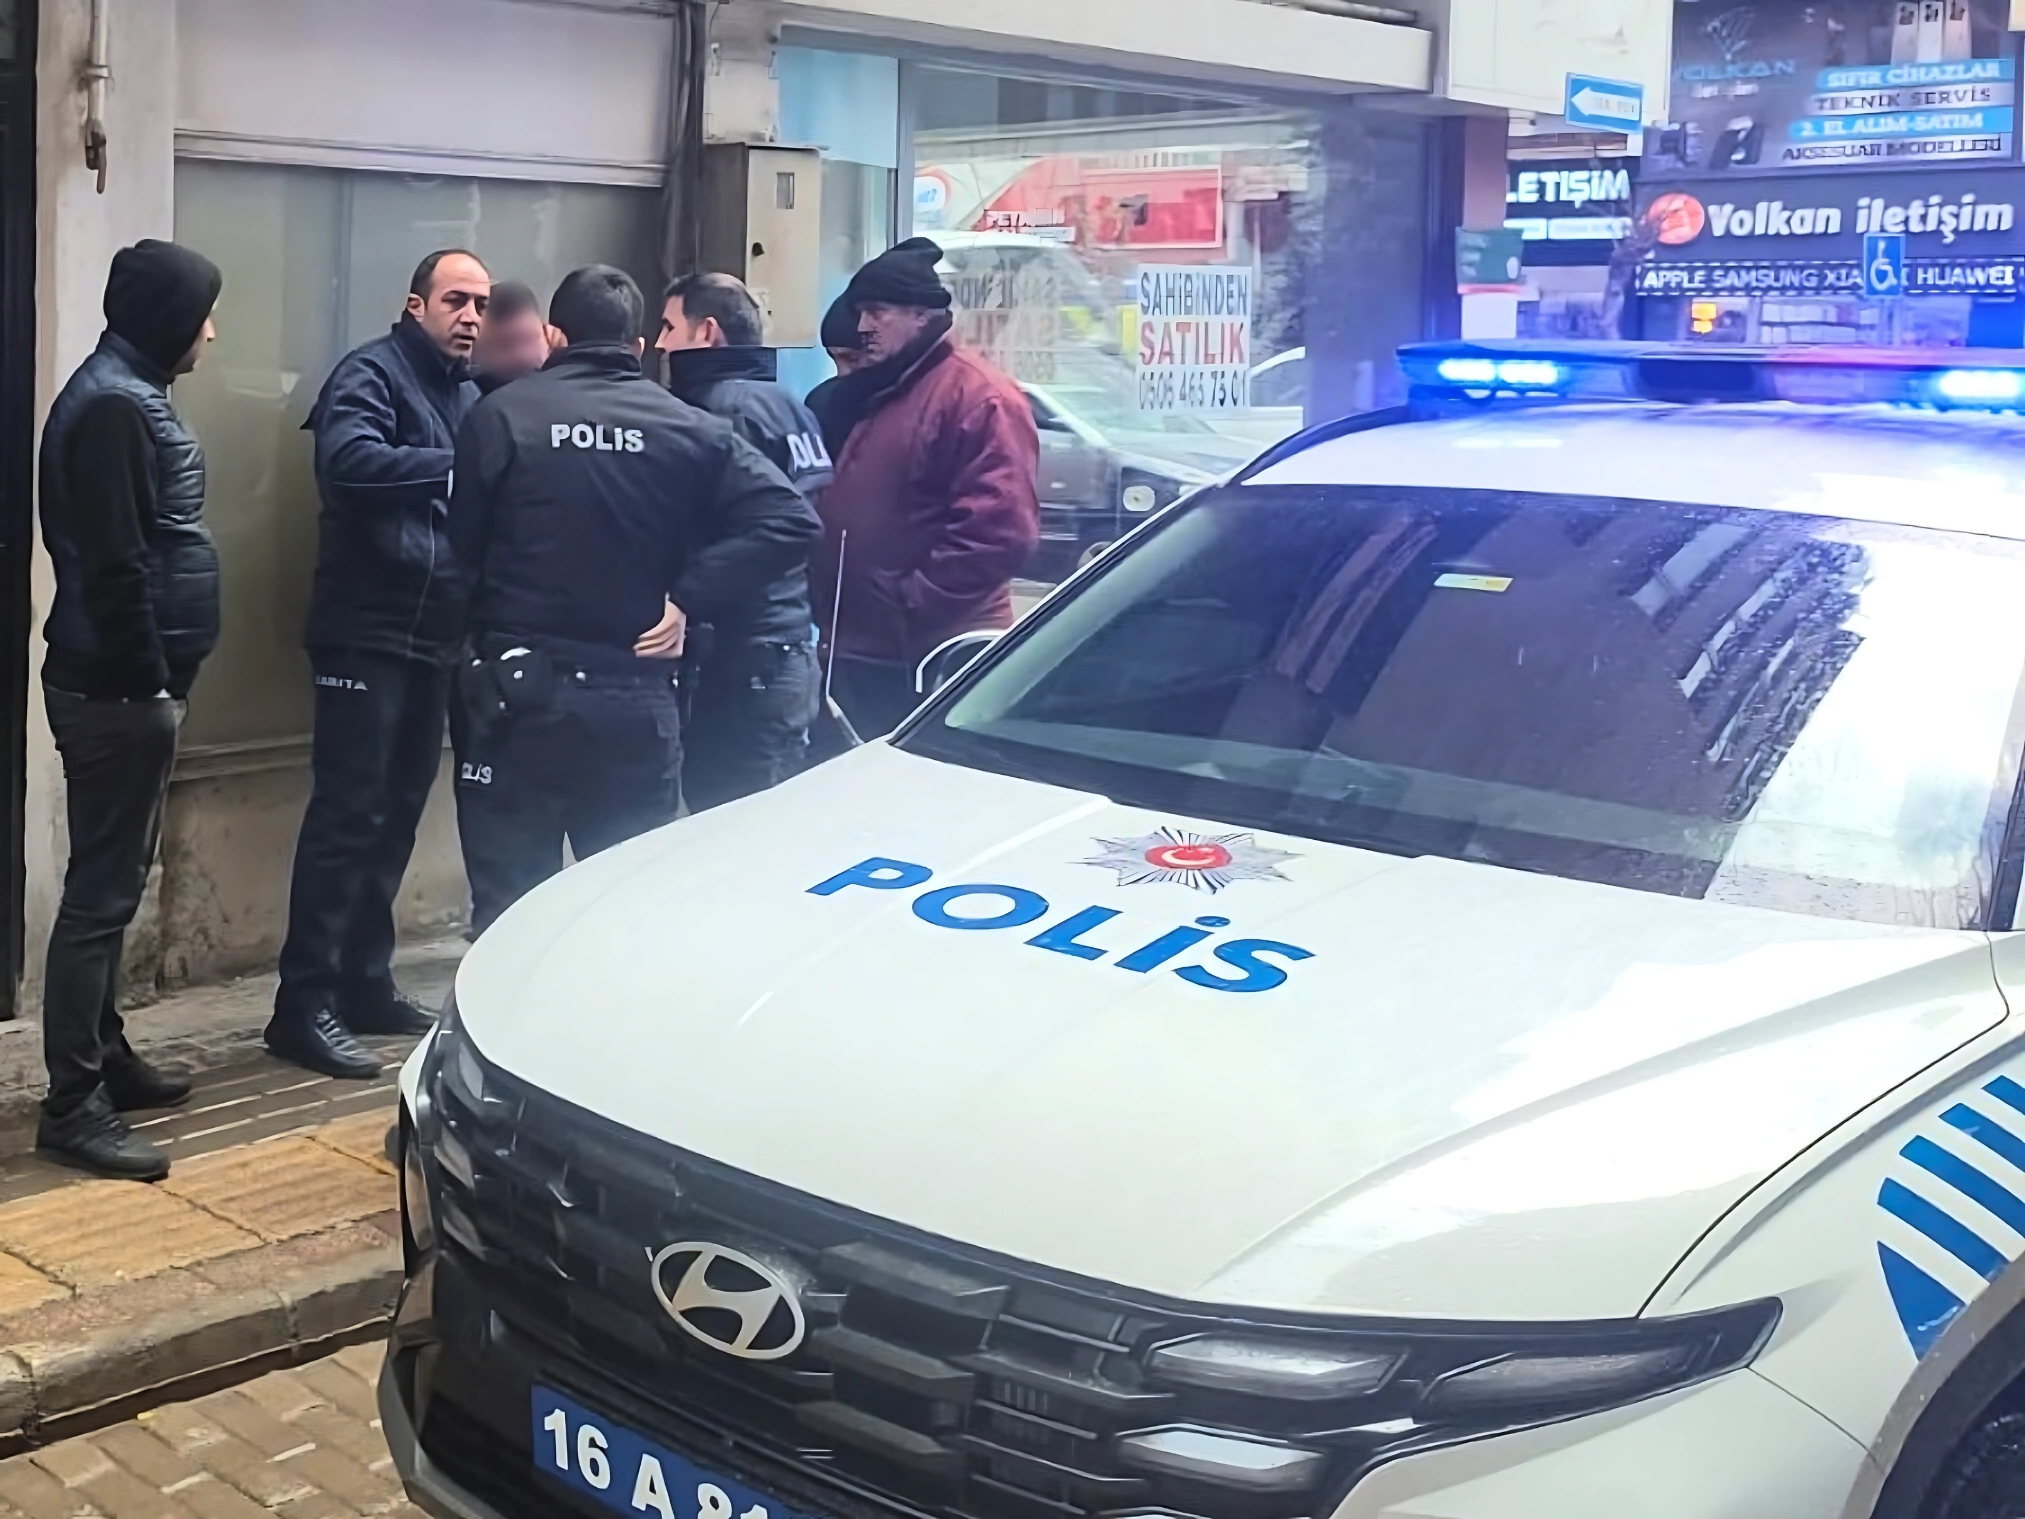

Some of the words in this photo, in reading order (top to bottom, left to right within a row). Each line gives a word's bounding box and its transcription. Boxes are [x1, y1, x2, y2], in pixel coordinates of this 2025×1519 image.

[1707, 201, 1842, 237] Volkan
[1855, 192, 2014, 245] iletişim
[1643, 269, 1707, 289] APPLE
[1712, 268, 1819, 288] SAMSUNG
[1917, 265, 2015, 286] HUAWEI
[1139, 320, 1245, 365] SATILIK
[804, 856, 1317, 993] POLİS
[544, 1408, 611, 1490] 16
[631, 1453, 676, 1519] A
